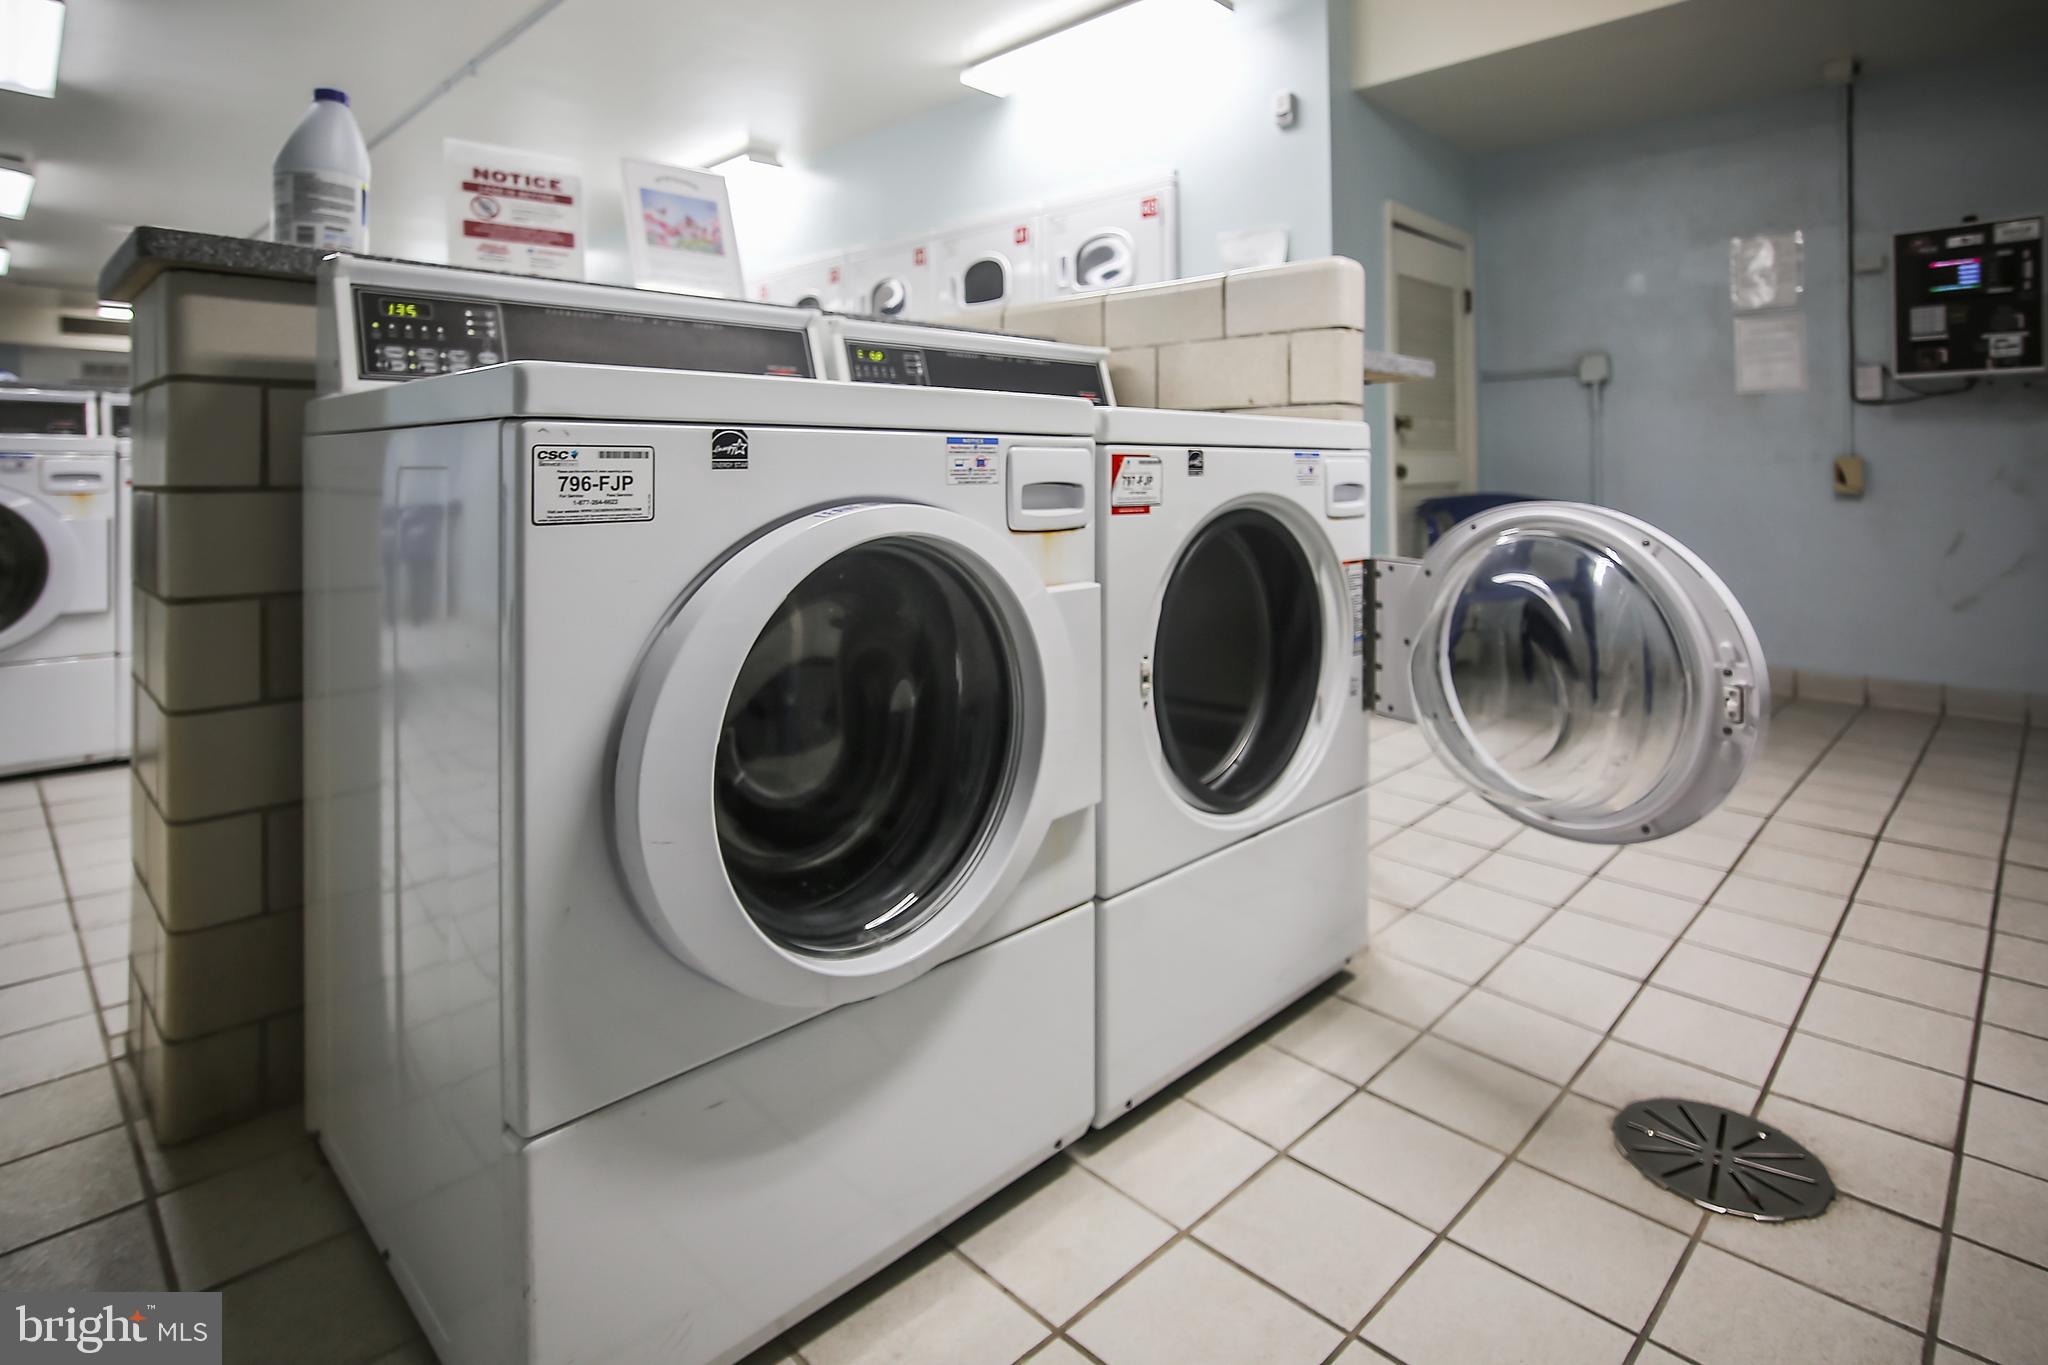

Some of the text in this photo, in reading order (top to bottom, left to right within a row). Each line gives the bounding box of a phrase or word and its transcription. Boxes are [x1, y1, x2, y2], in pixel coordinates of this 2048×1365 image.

[472, 167, 561, 190] NOTICE
[537, 450, 569, 460] CSC
[558, 475, 633, 492] 796-FJP
